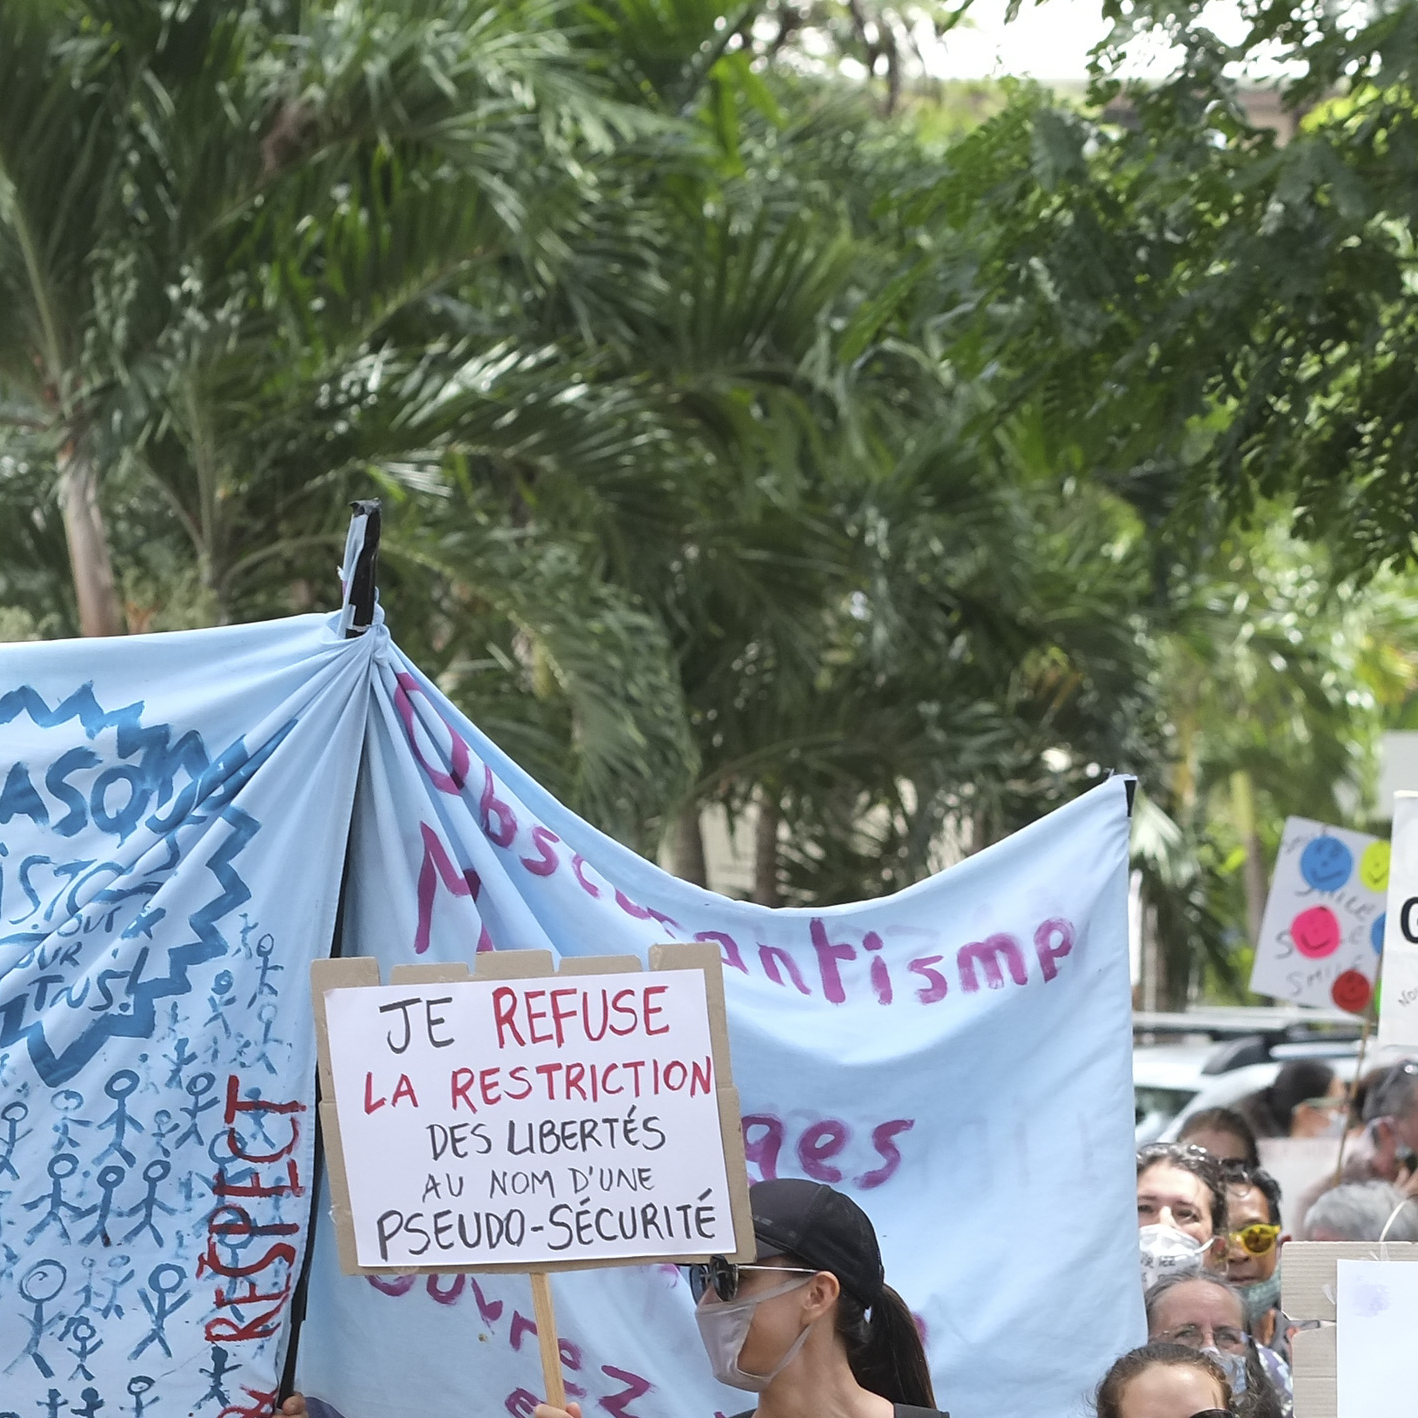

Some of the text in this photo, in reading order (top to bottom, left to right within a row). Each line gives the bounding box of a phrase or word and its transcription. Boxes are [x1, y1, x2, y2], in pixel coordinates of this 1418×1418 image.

[379, 985, 670, 1055] JE REFUSE
[364, 1055, 713, 1115] LA RESTRICTION
[426, 1104, 667, 1161] DES LIBERTÉS
[196, 1074, 307, 1342] RESPECT
[421, 1165, 656, 1203] AU NOM D'UNE
[376, 1188, 717, 1262] PSEUDO-SÉCURITÉ
